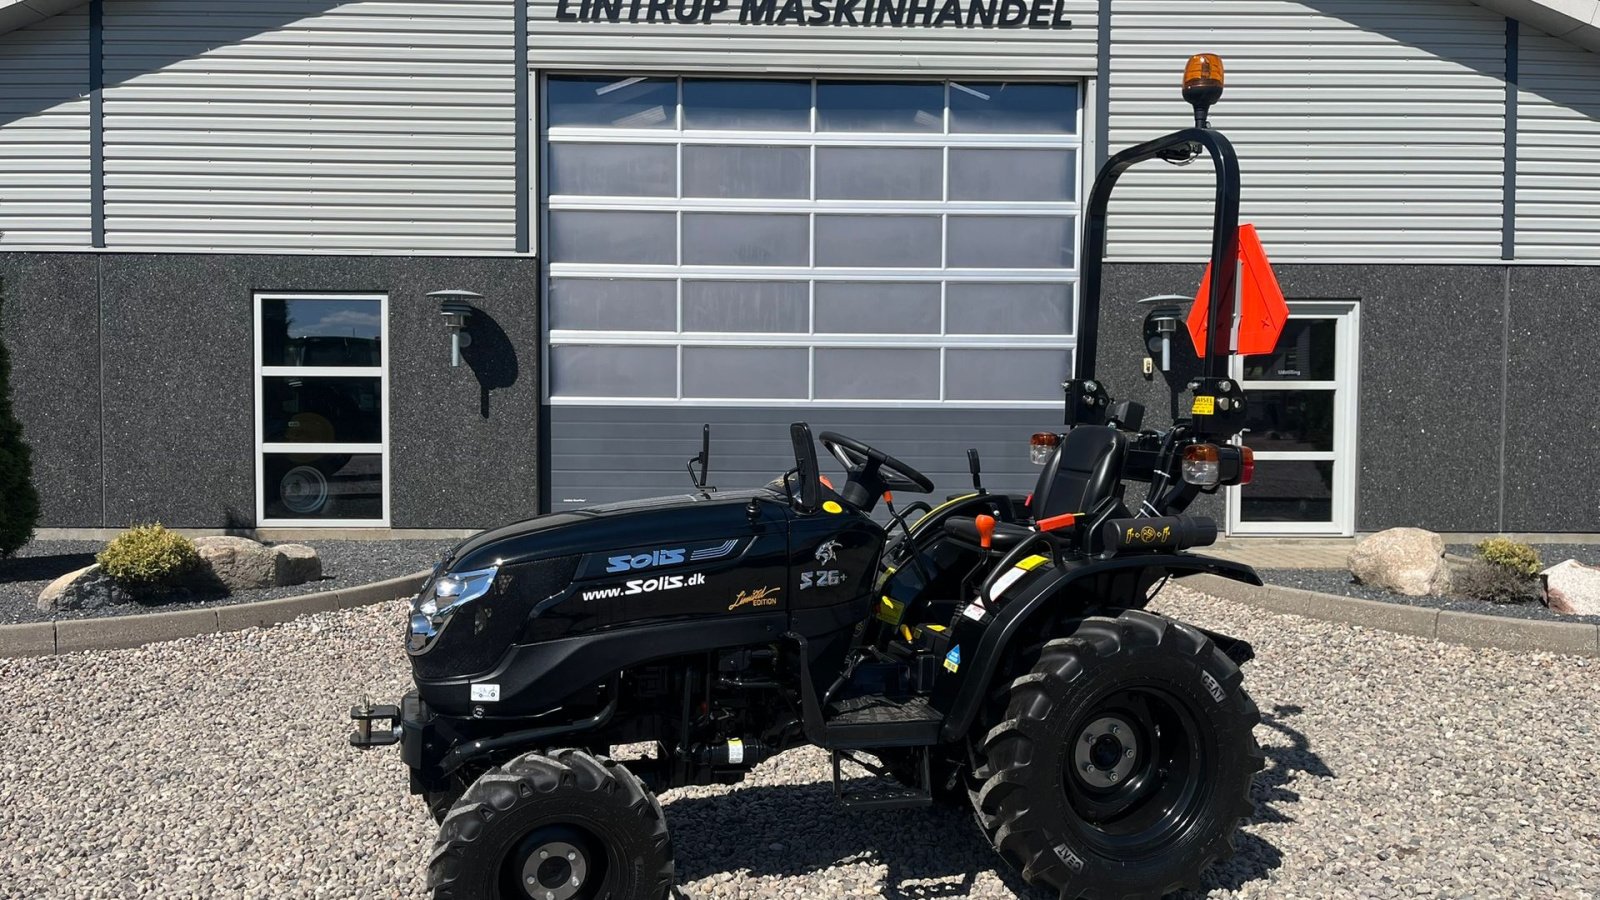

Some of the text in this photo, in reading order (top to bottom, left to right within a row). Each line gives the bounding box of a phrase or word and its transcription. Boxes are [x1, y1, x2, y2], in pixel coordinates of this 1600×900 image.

[556, 0, 1072, 29] LINTRUP MASKINHANDEL
[752, 597, 777, 606] EDITION
[1202, 674, 1225, 700] CEAT
[1056, 845, 1081, 871] CEAT
